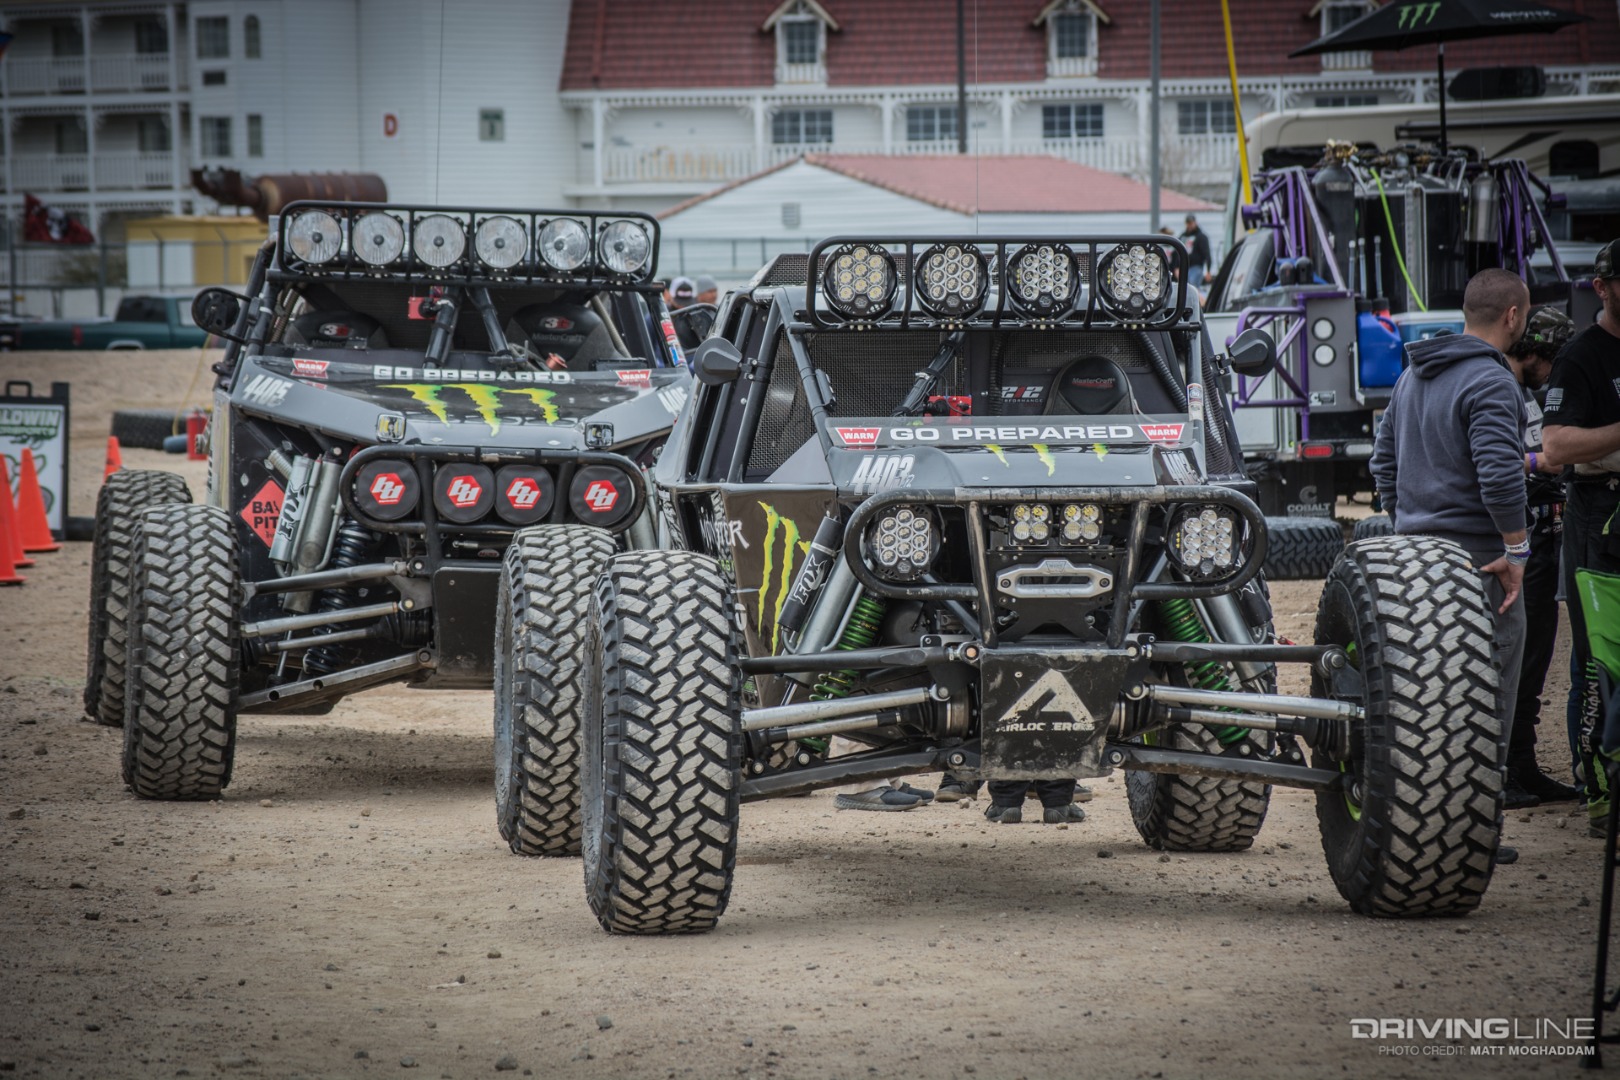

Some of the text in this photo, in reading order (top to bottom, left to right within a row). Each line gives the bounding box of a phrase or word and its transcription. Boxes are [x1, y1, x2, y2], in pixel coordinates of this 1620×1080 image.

[383, 112, 399, 138] D
[373, 366, 413, 380] GO
[622, 372, 647, 380] WARN
[242, 374, 294, 404] 4405
[843, 432, 875, 440] WARN
[889, 425, 1134, 442] GO PREPARED
[1147, 428, 1178, 437] WARN
[277, 483, 308, 541] FOX
[1287, 503, 1331, 512] COBALT
[793, 554, 828, 605] FOX
